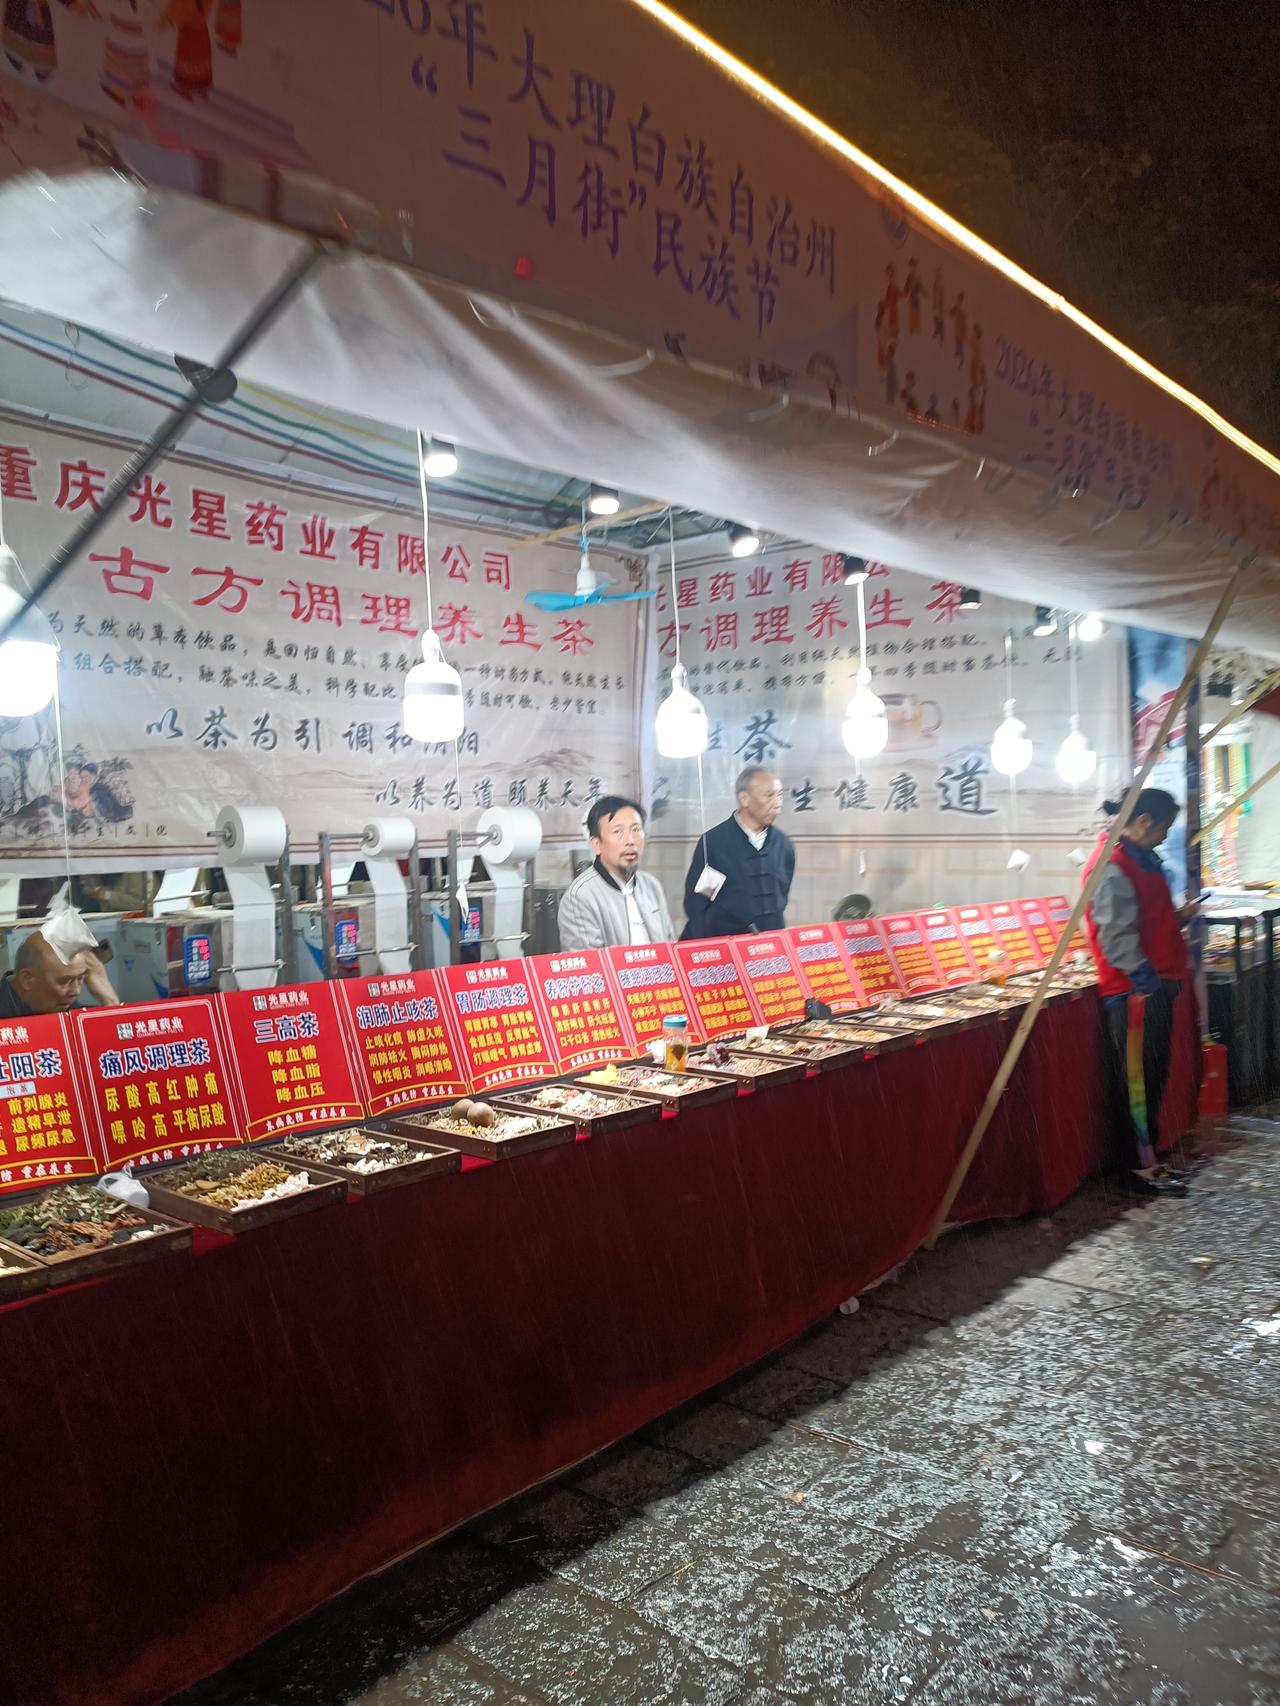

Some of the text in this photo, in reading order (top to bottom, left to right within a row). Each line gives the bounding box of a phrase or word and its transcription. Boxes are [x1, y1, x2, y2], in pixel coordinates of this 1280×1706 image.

[411, 54, 784, 337] “三月街”民族节
[0, 444, 513, 591] 重庆光星药业有限公司
[88, 545, 595, 657] 古方调理养生茶
[146, 706, 326, 752] 以茶为引
[375, 776, 495, 813] 以养为道
[790, 759, 998, 818] 生健康道
[268, 989, 309, 1006] 光星药业
[356, 996, 439, 1030] 润肺止咳茶
[134, 1015, 183, 1034] 光星药业
[254, 1011, 319, 1043] 三高茶
[365, 1031, 404, 1050] 止咳化痰
[99, 1037, 211, 1079] 痛风调理茶
[267, 1044, 318, 1066] 降血糖
[271, 1062, 321, 1084] 降血脂
[7, 1091, 69, 1115] 前列腺炎
[275, 1081, 325, 1103] 降血压
[11, 1109, 72, 1134] 遗精早泄
[110, 1101, 227, 1145] 嘌呤高 平衡尿酸
[15, 1127, 76, 1153] 尿频尿急
